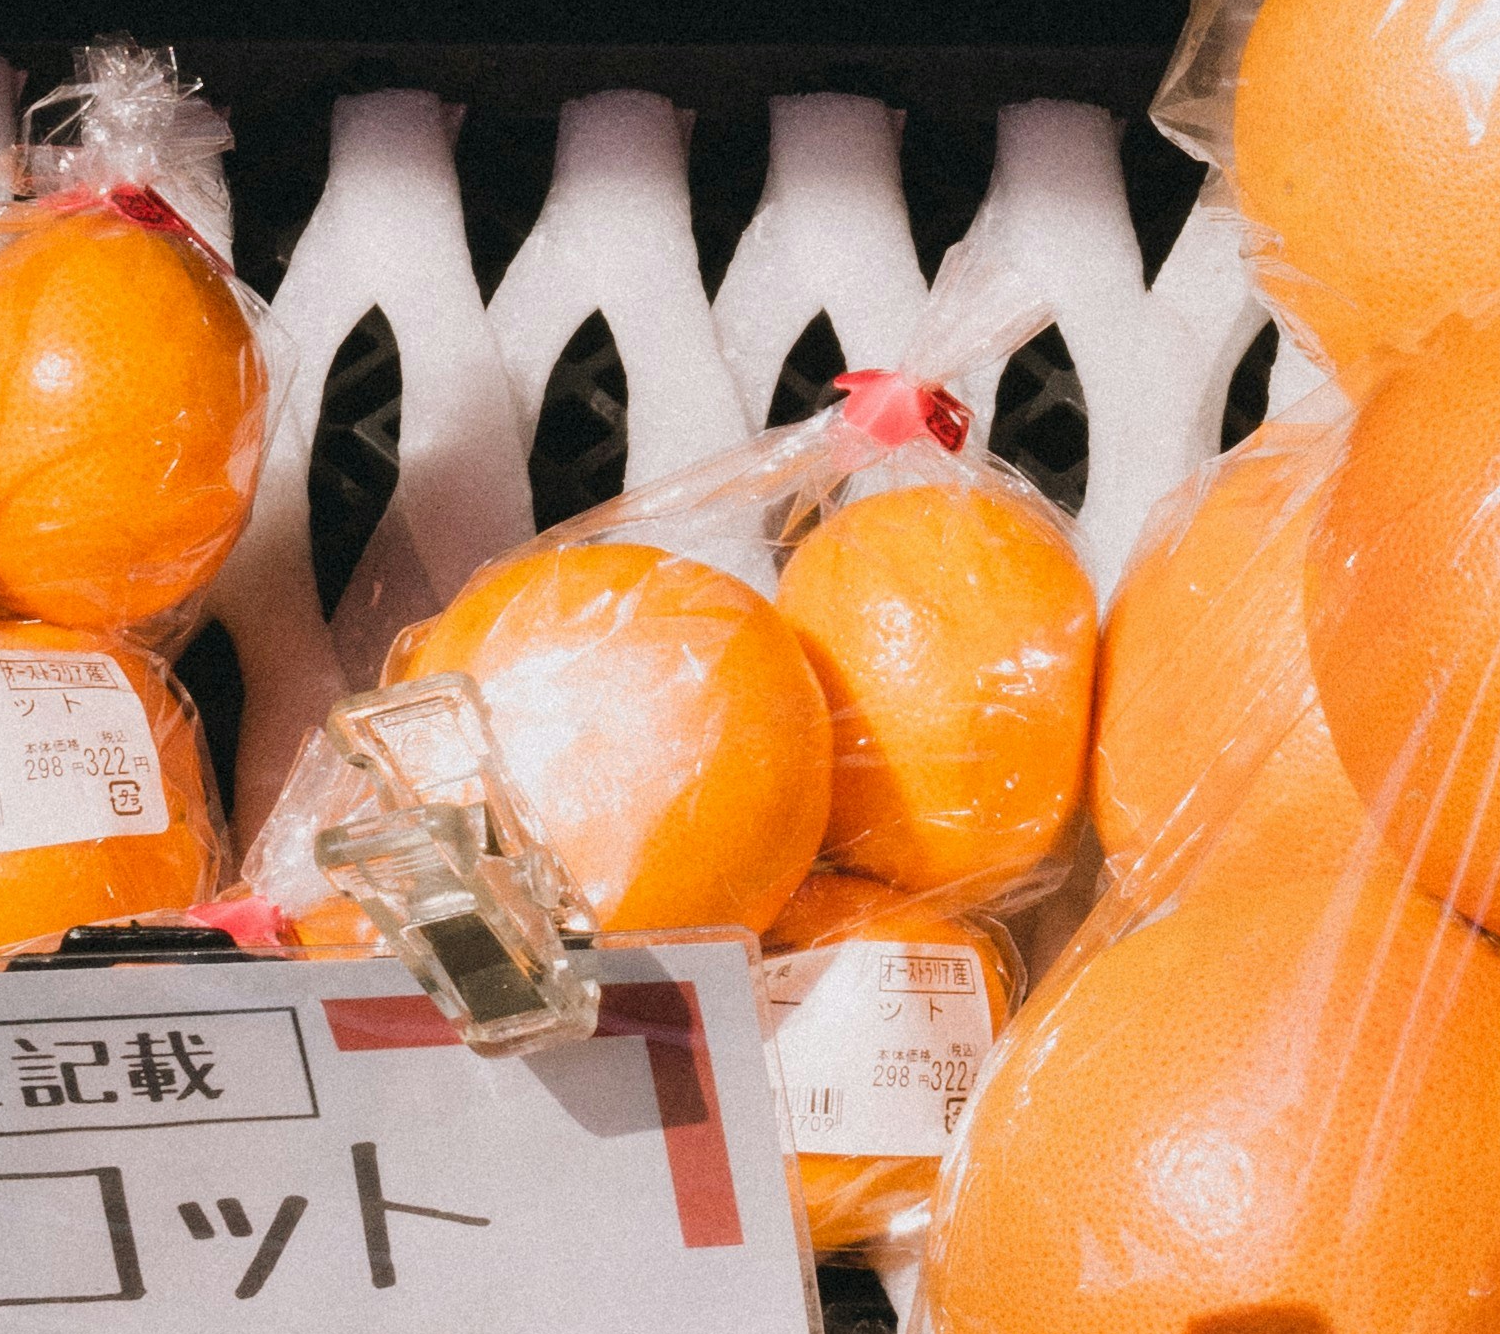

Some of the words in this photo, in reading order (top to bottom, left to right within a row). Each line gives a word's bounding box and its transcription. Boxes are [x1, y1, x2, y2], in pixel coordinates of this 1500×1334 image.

[884, 958, 970, 985] オーストラリア産
